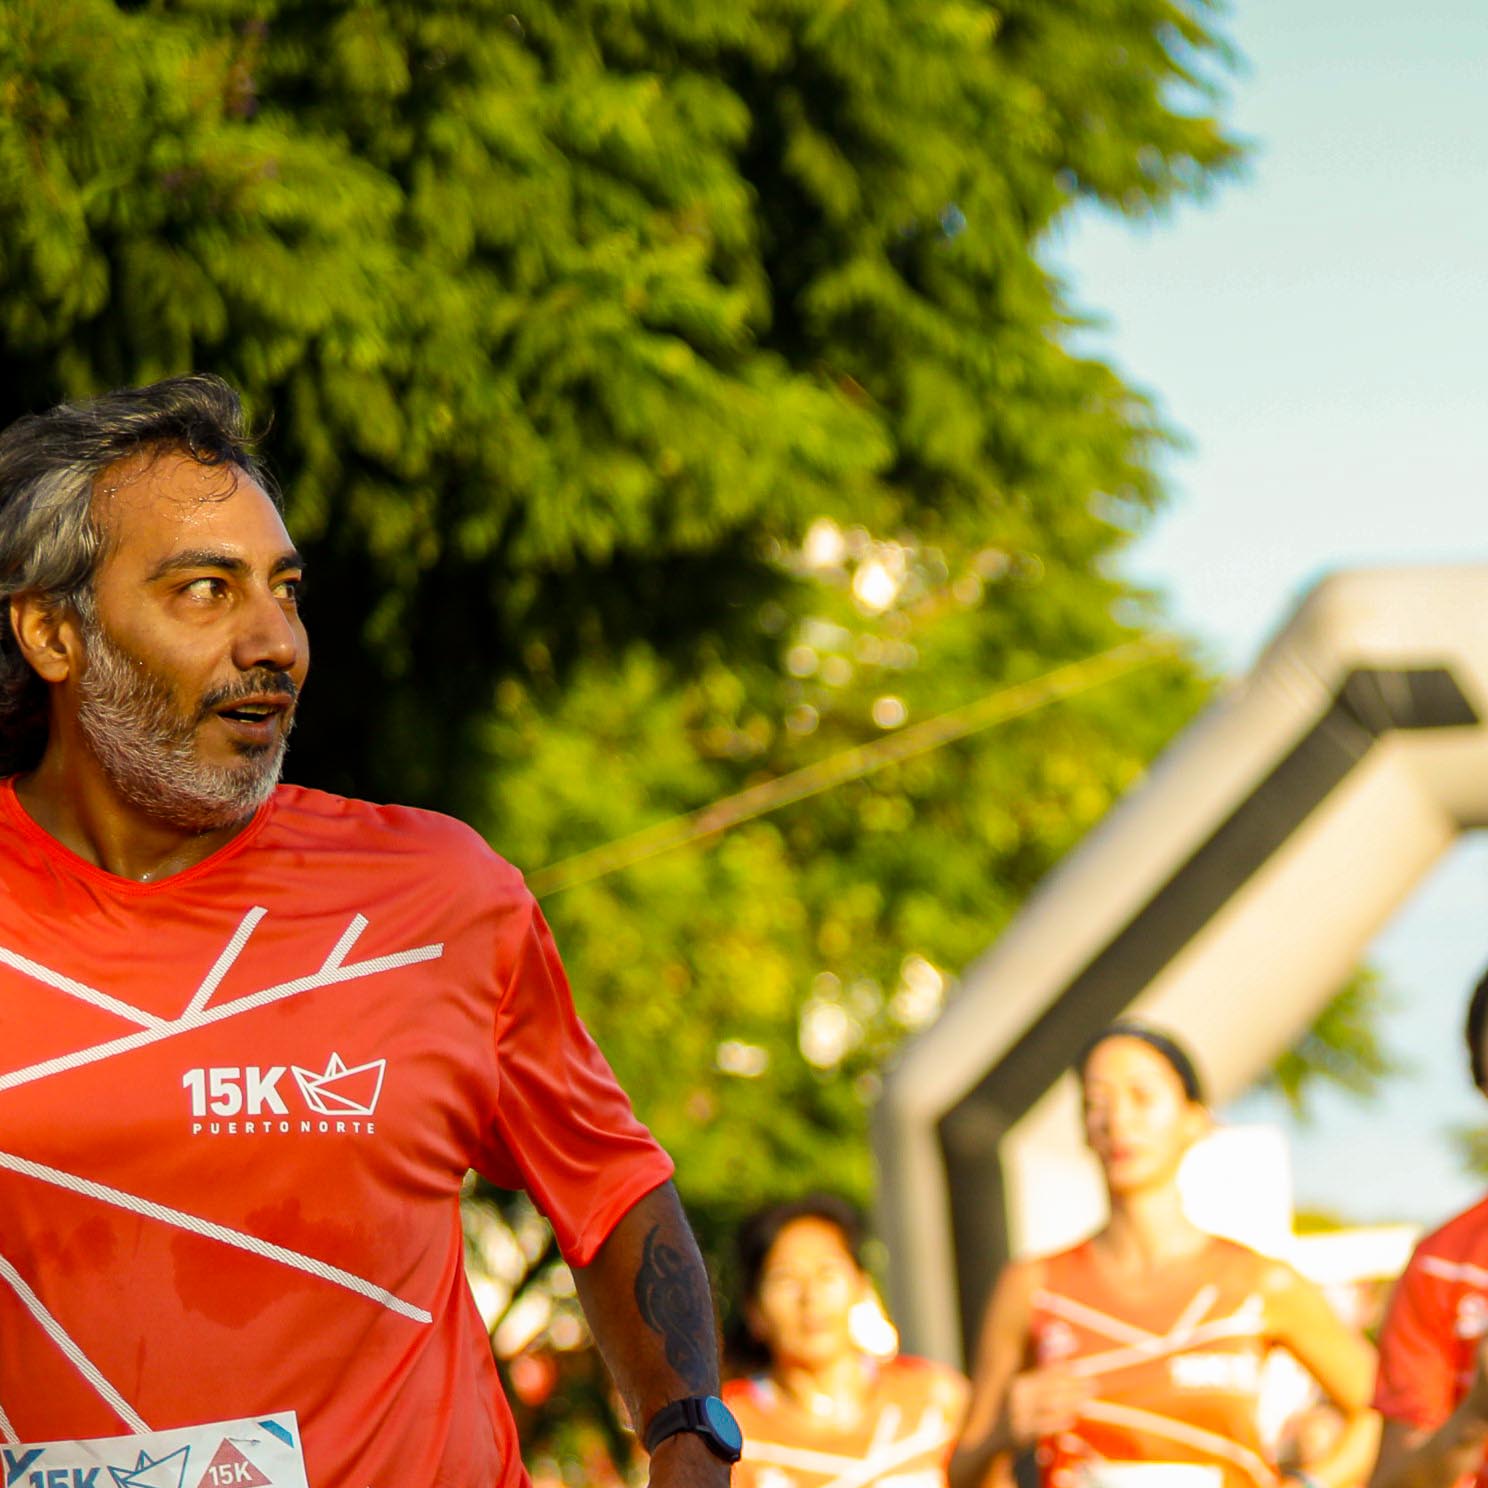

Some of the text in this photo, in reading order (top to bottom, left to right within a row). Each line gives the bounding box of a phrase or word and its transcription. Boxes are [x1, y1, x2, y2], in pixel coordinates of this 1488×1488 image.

[182, 1066, 289, 1117] 15K
[192, 1121, 375, 1135] PUERTO NORTE
[207, 1461, 253, 1487] 15K
